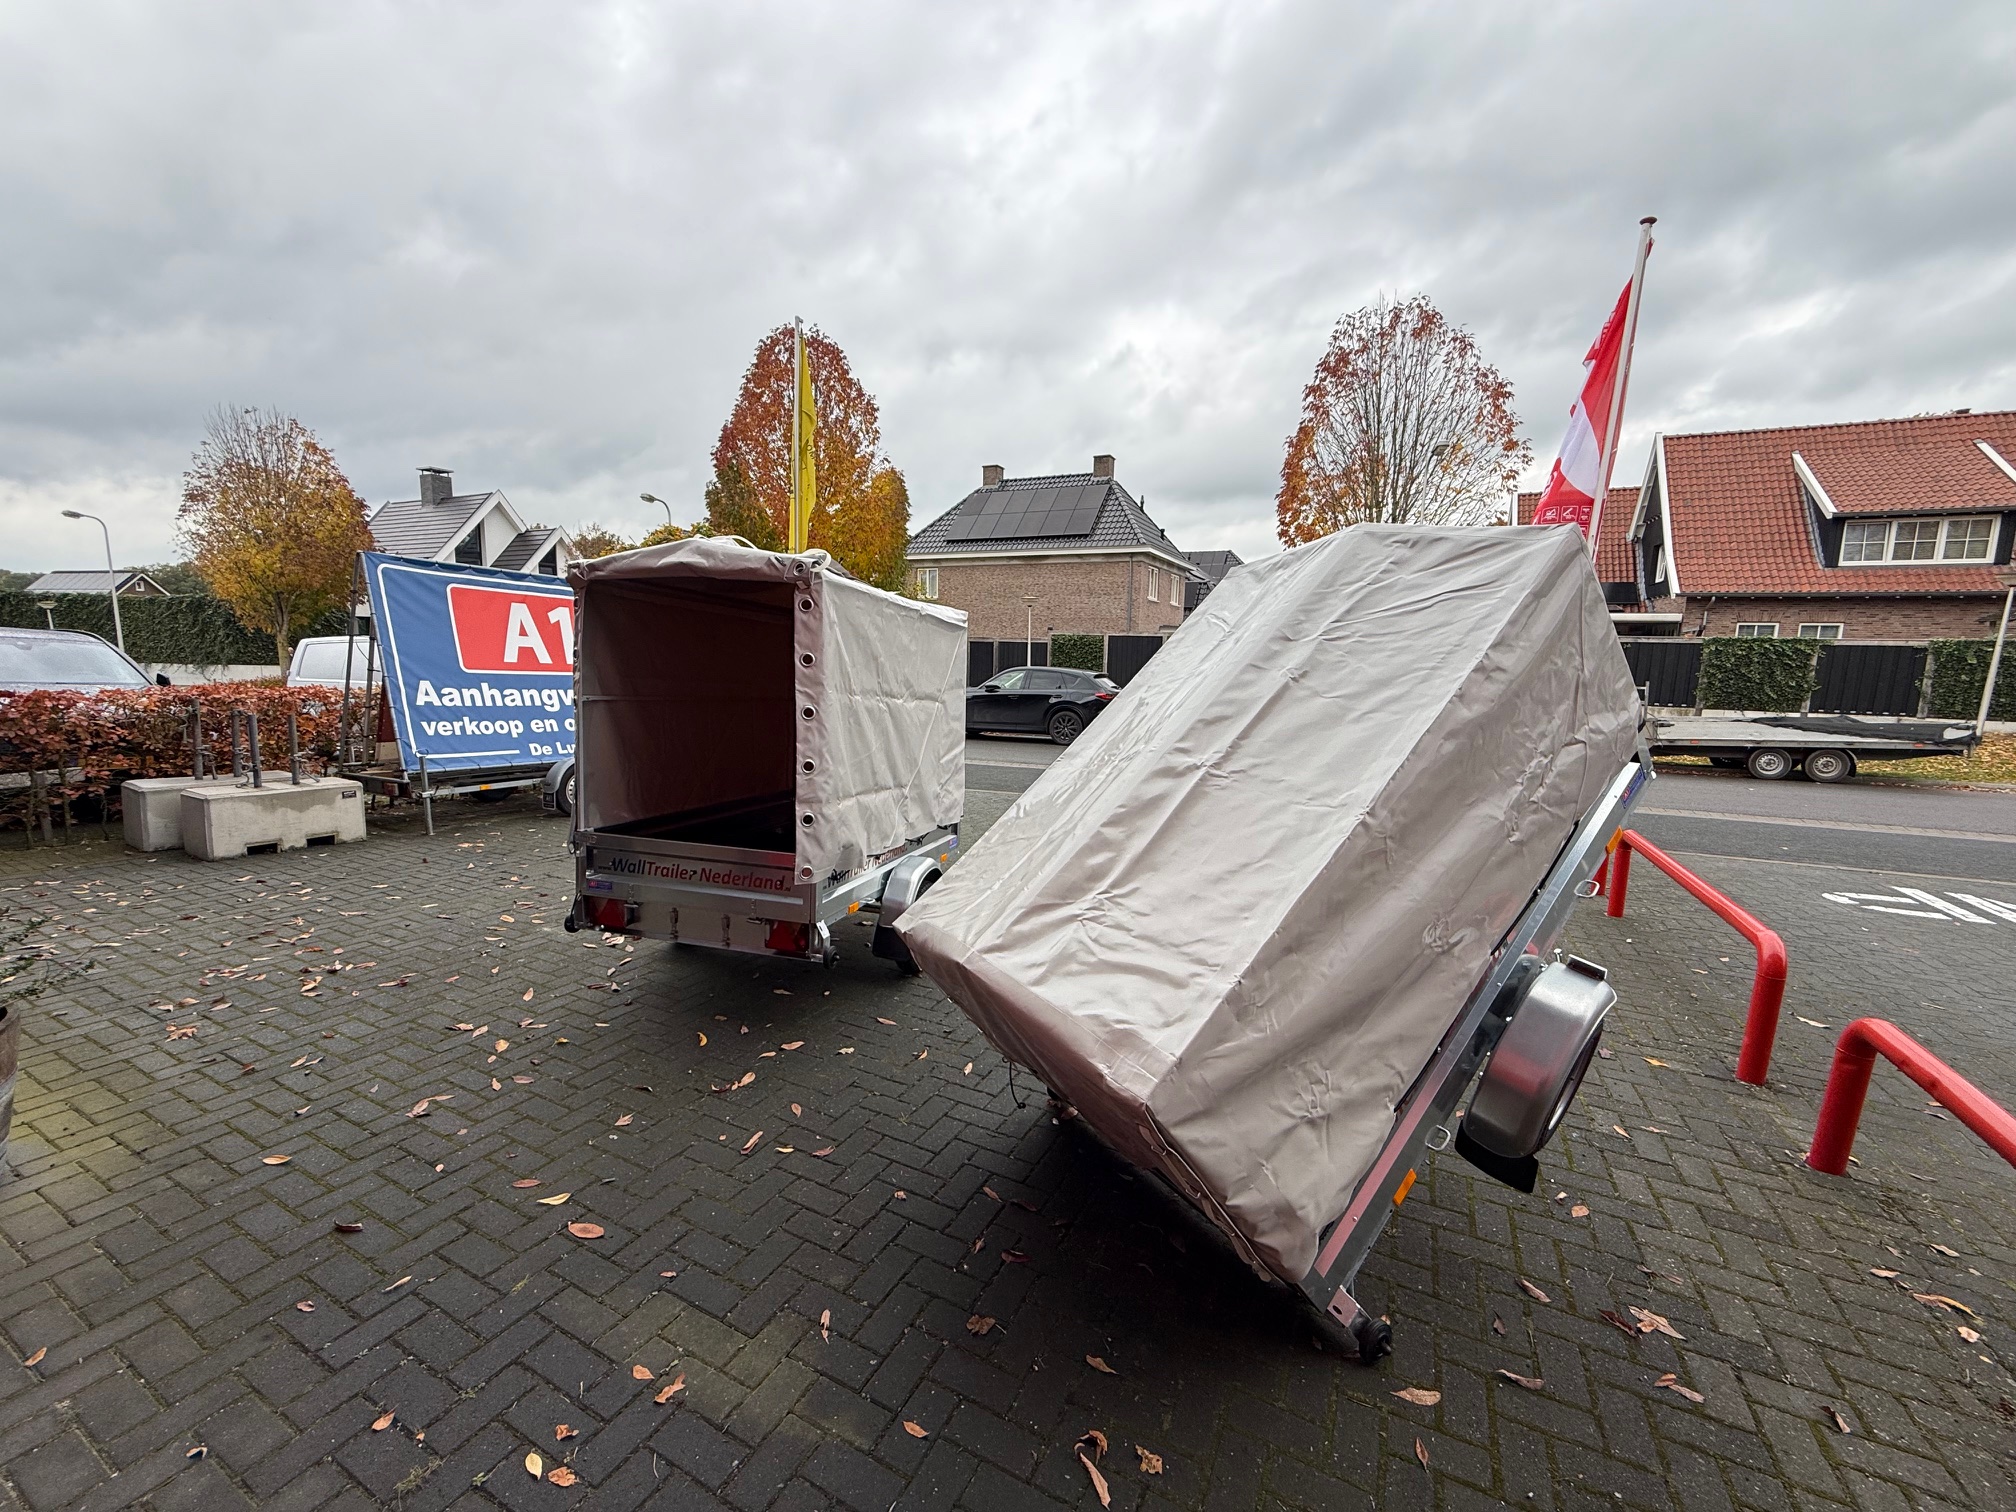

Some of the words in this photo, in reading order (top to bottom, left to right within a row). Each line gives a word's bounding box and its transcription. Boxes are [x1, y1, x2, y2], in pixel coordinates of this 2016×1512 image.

[504, 602, 573, 664] A1
[421, 717, 524, 738] verkoop
[530, 718, 559, 733] en
[529, 743, 553, 756] De
